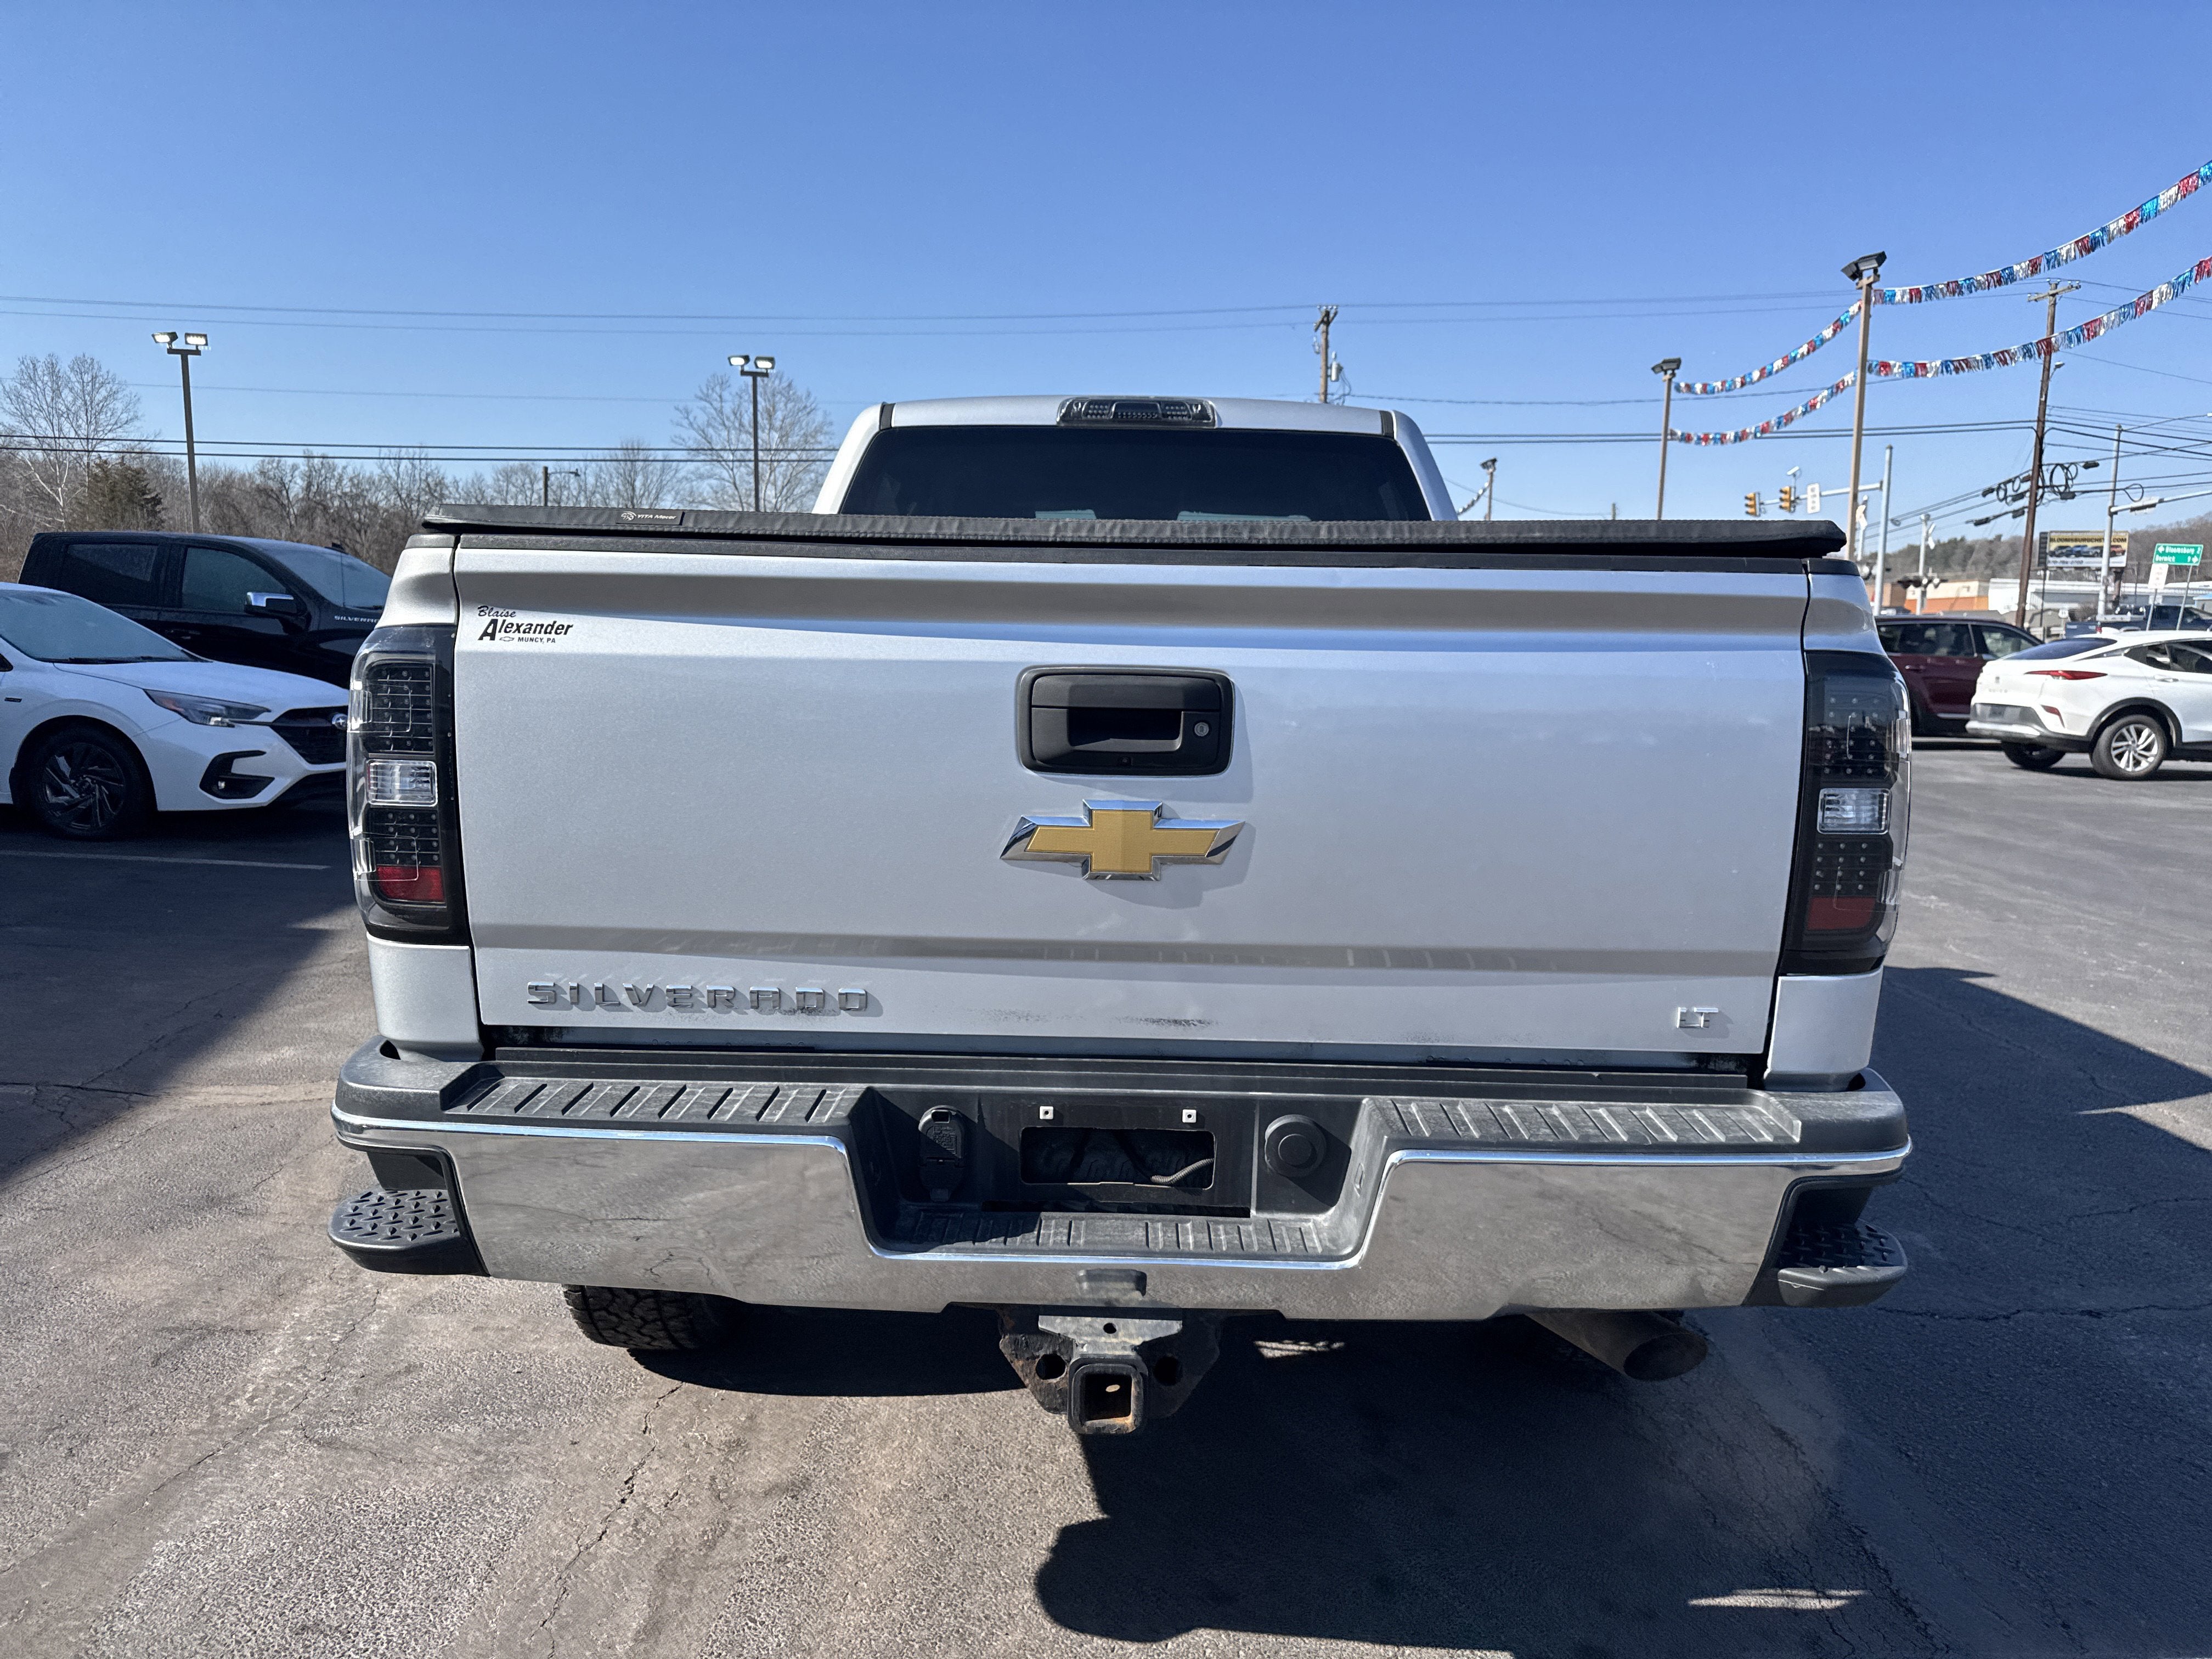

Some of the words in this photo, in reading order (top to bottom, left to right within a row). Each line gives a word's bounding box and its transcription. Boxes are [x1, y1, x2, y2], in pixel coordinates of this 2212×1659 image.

[477, 605, 516, 618] Blaise
[477, 618, 574, 641] Alexander
[527, 981, 868, 1011] SILVERADO
[1677, 1007, 1719, 1029] LT
